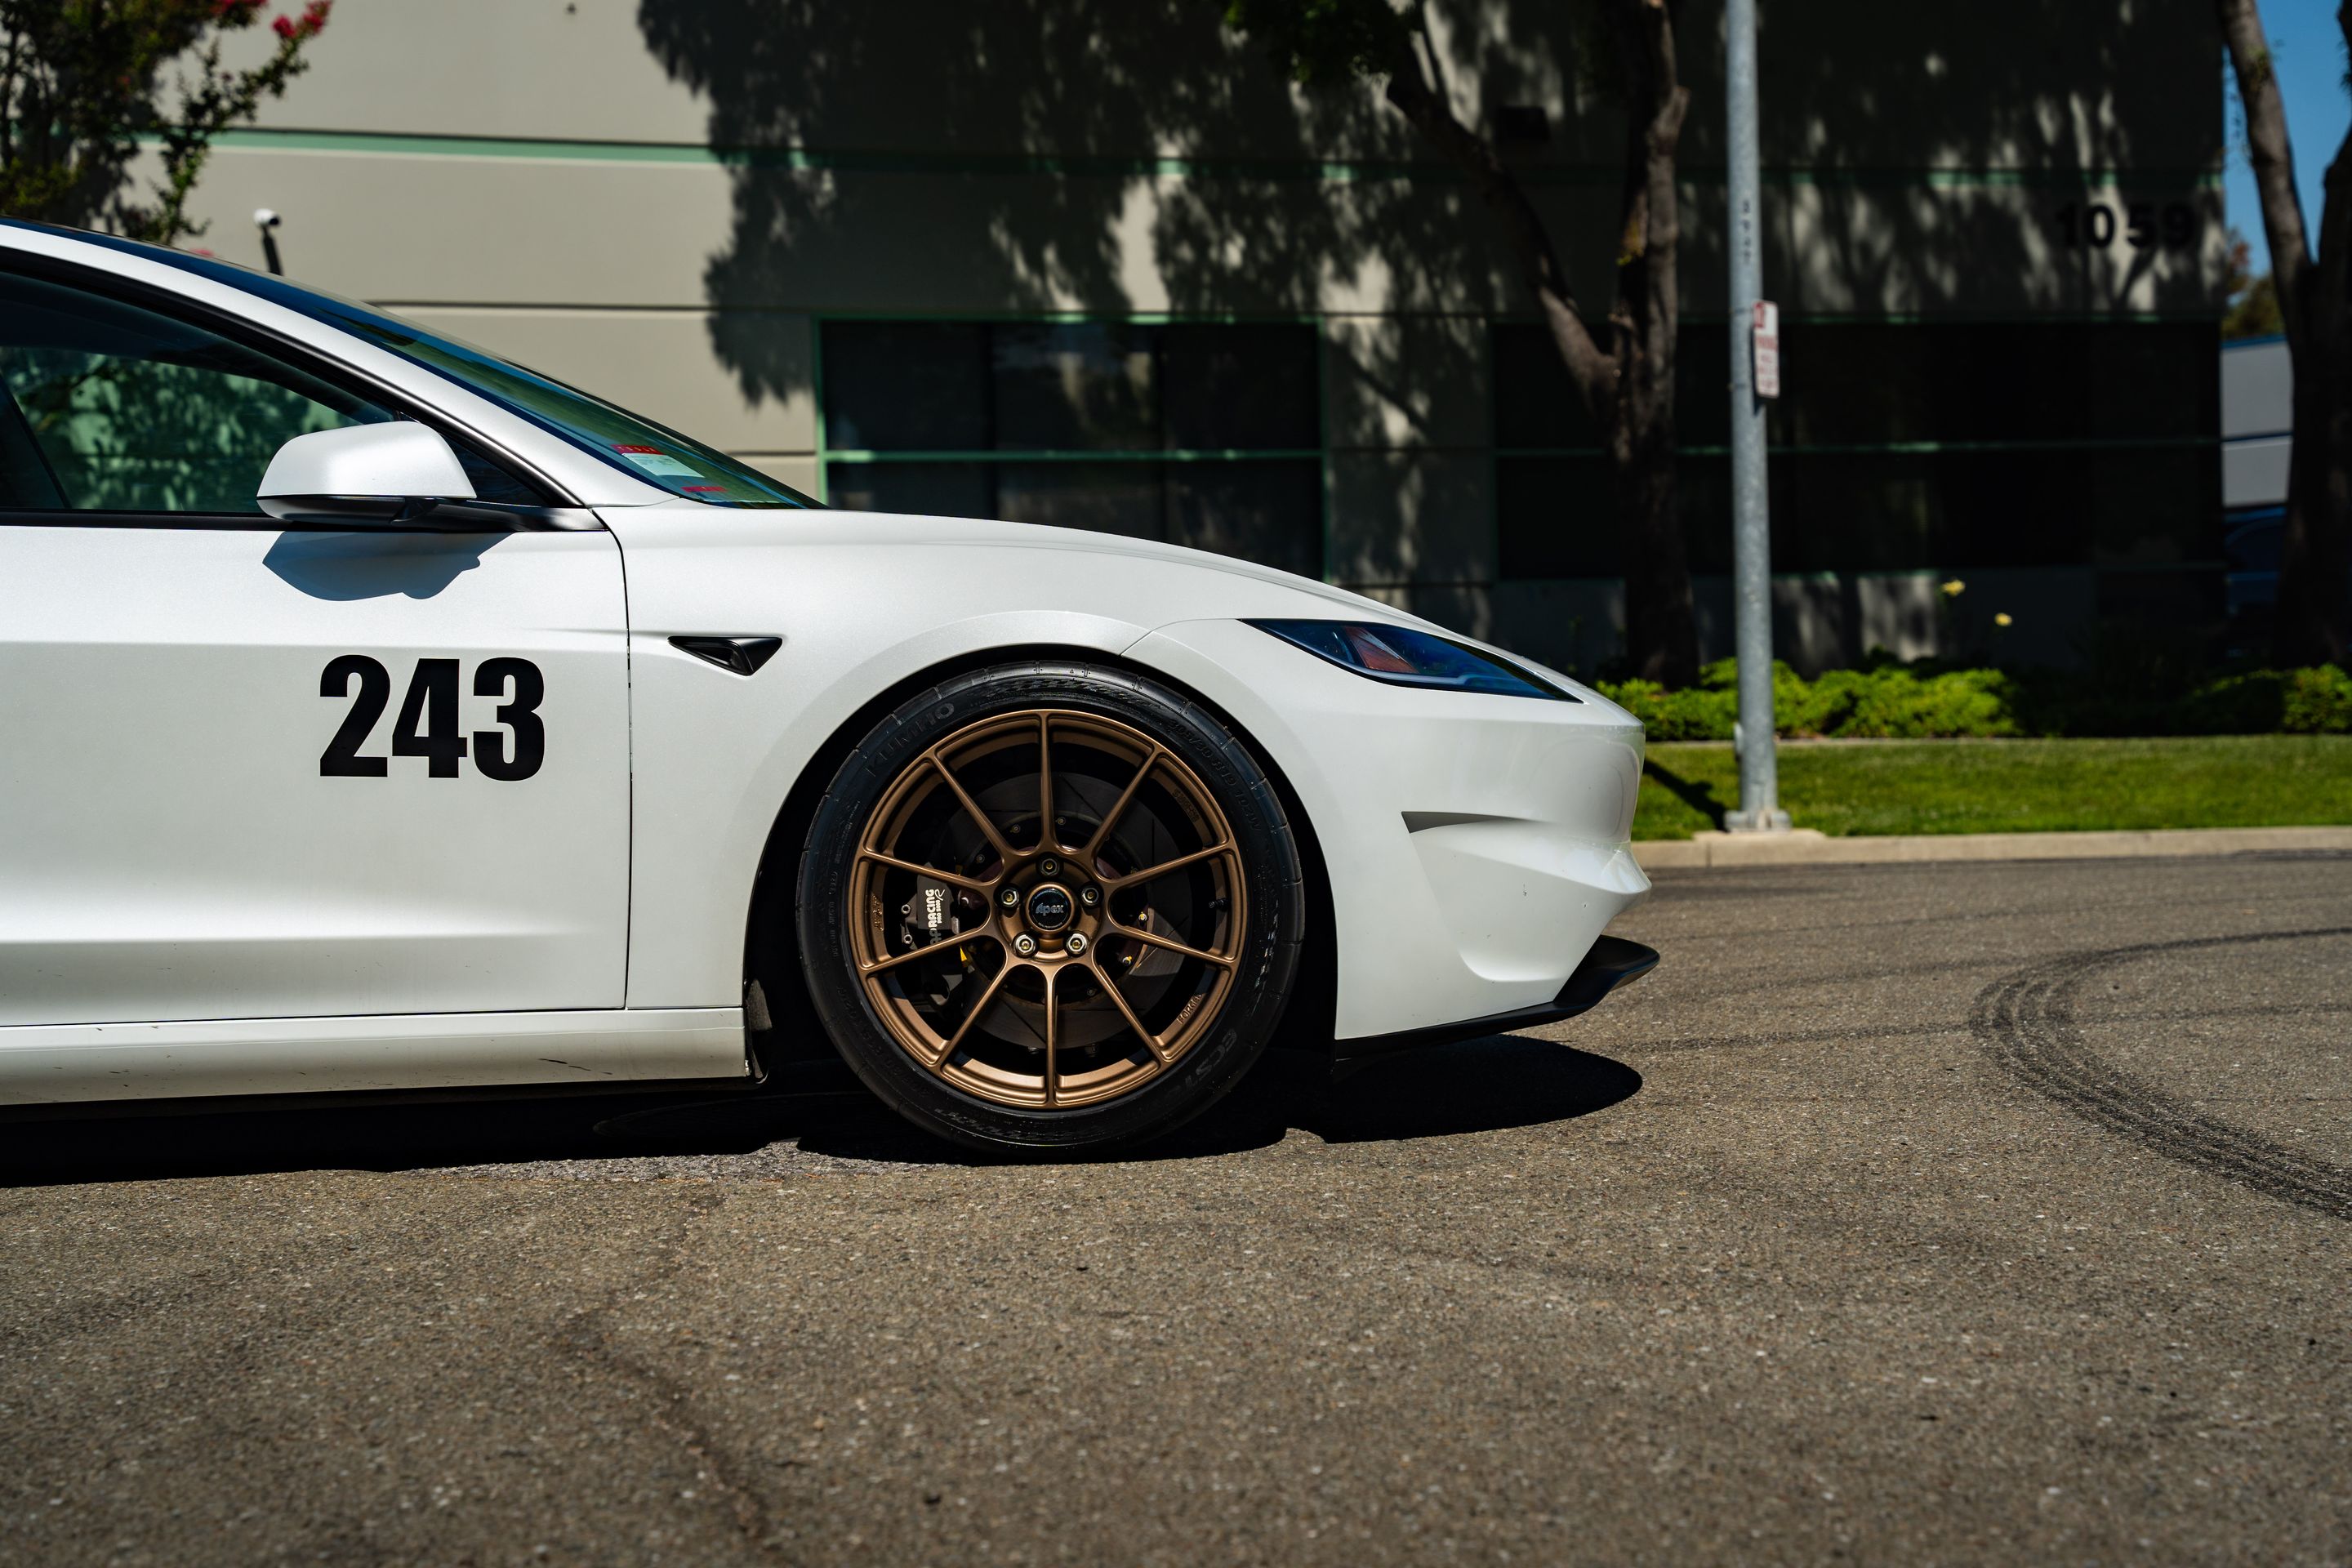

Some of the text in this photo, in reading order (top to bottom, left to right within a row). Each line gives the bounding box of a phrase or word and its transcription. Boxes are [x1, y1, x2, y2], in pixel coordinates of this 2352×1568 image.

[2056, 203, 2194, 247] 1059
[320, 654, 545, 782] 243
[863, 702, 955, 777] KUMHO
[925, 889, 938, 928] RACING
[1036, 902, 1064, 916] Apex
